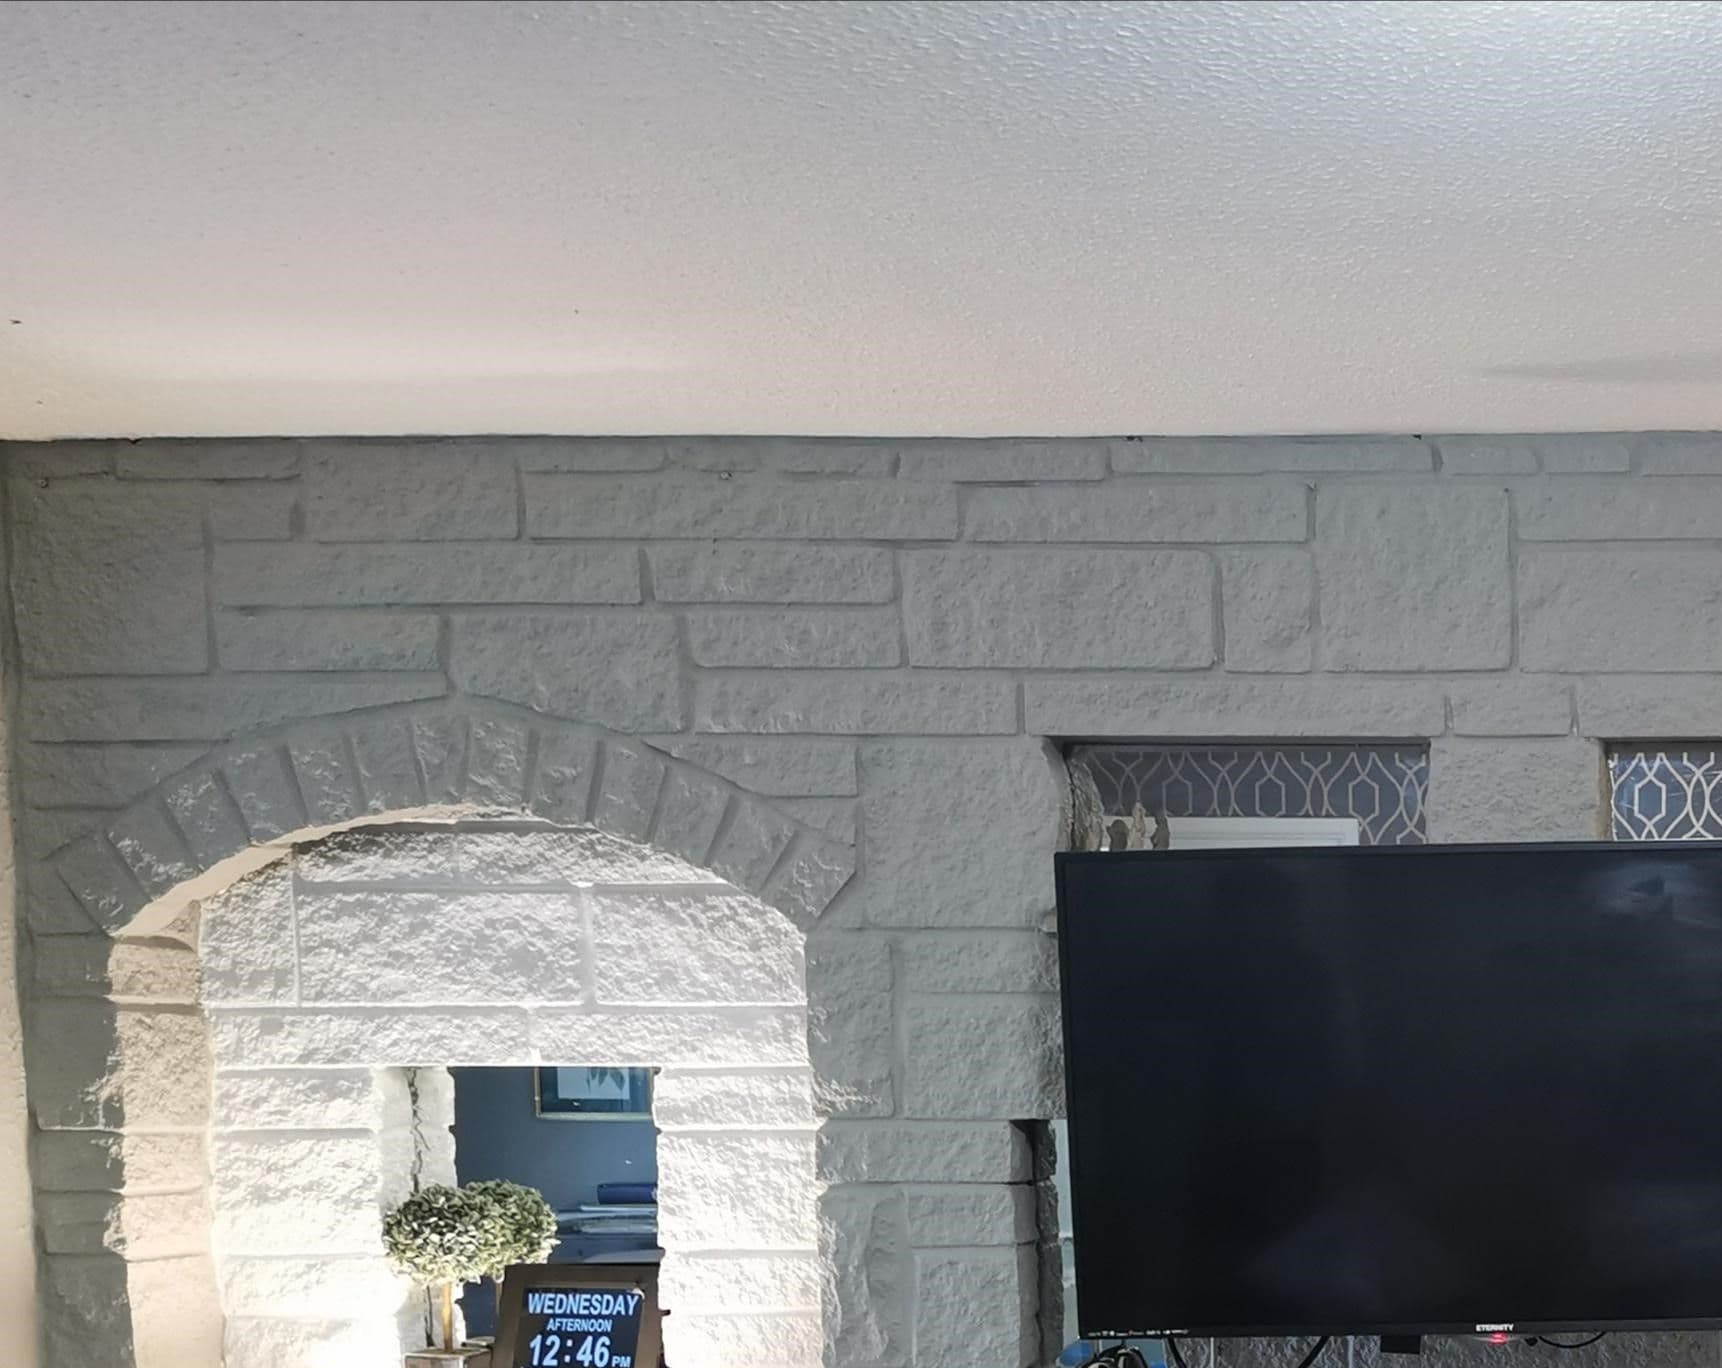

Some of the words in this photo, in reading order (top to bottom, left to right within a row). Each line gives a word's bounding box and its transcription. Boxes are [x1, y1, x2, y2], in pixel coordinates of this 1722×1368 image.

[528, 1293, 640, 1316] WEDNESDAY
[547, 1318, 613, 1332] AFTERNOON
[1476, 1322, 1514, 1332] ETERNITY
[530, 1334, 611, 1368] 12:46
[611, 1356, 631, 1368] PM
